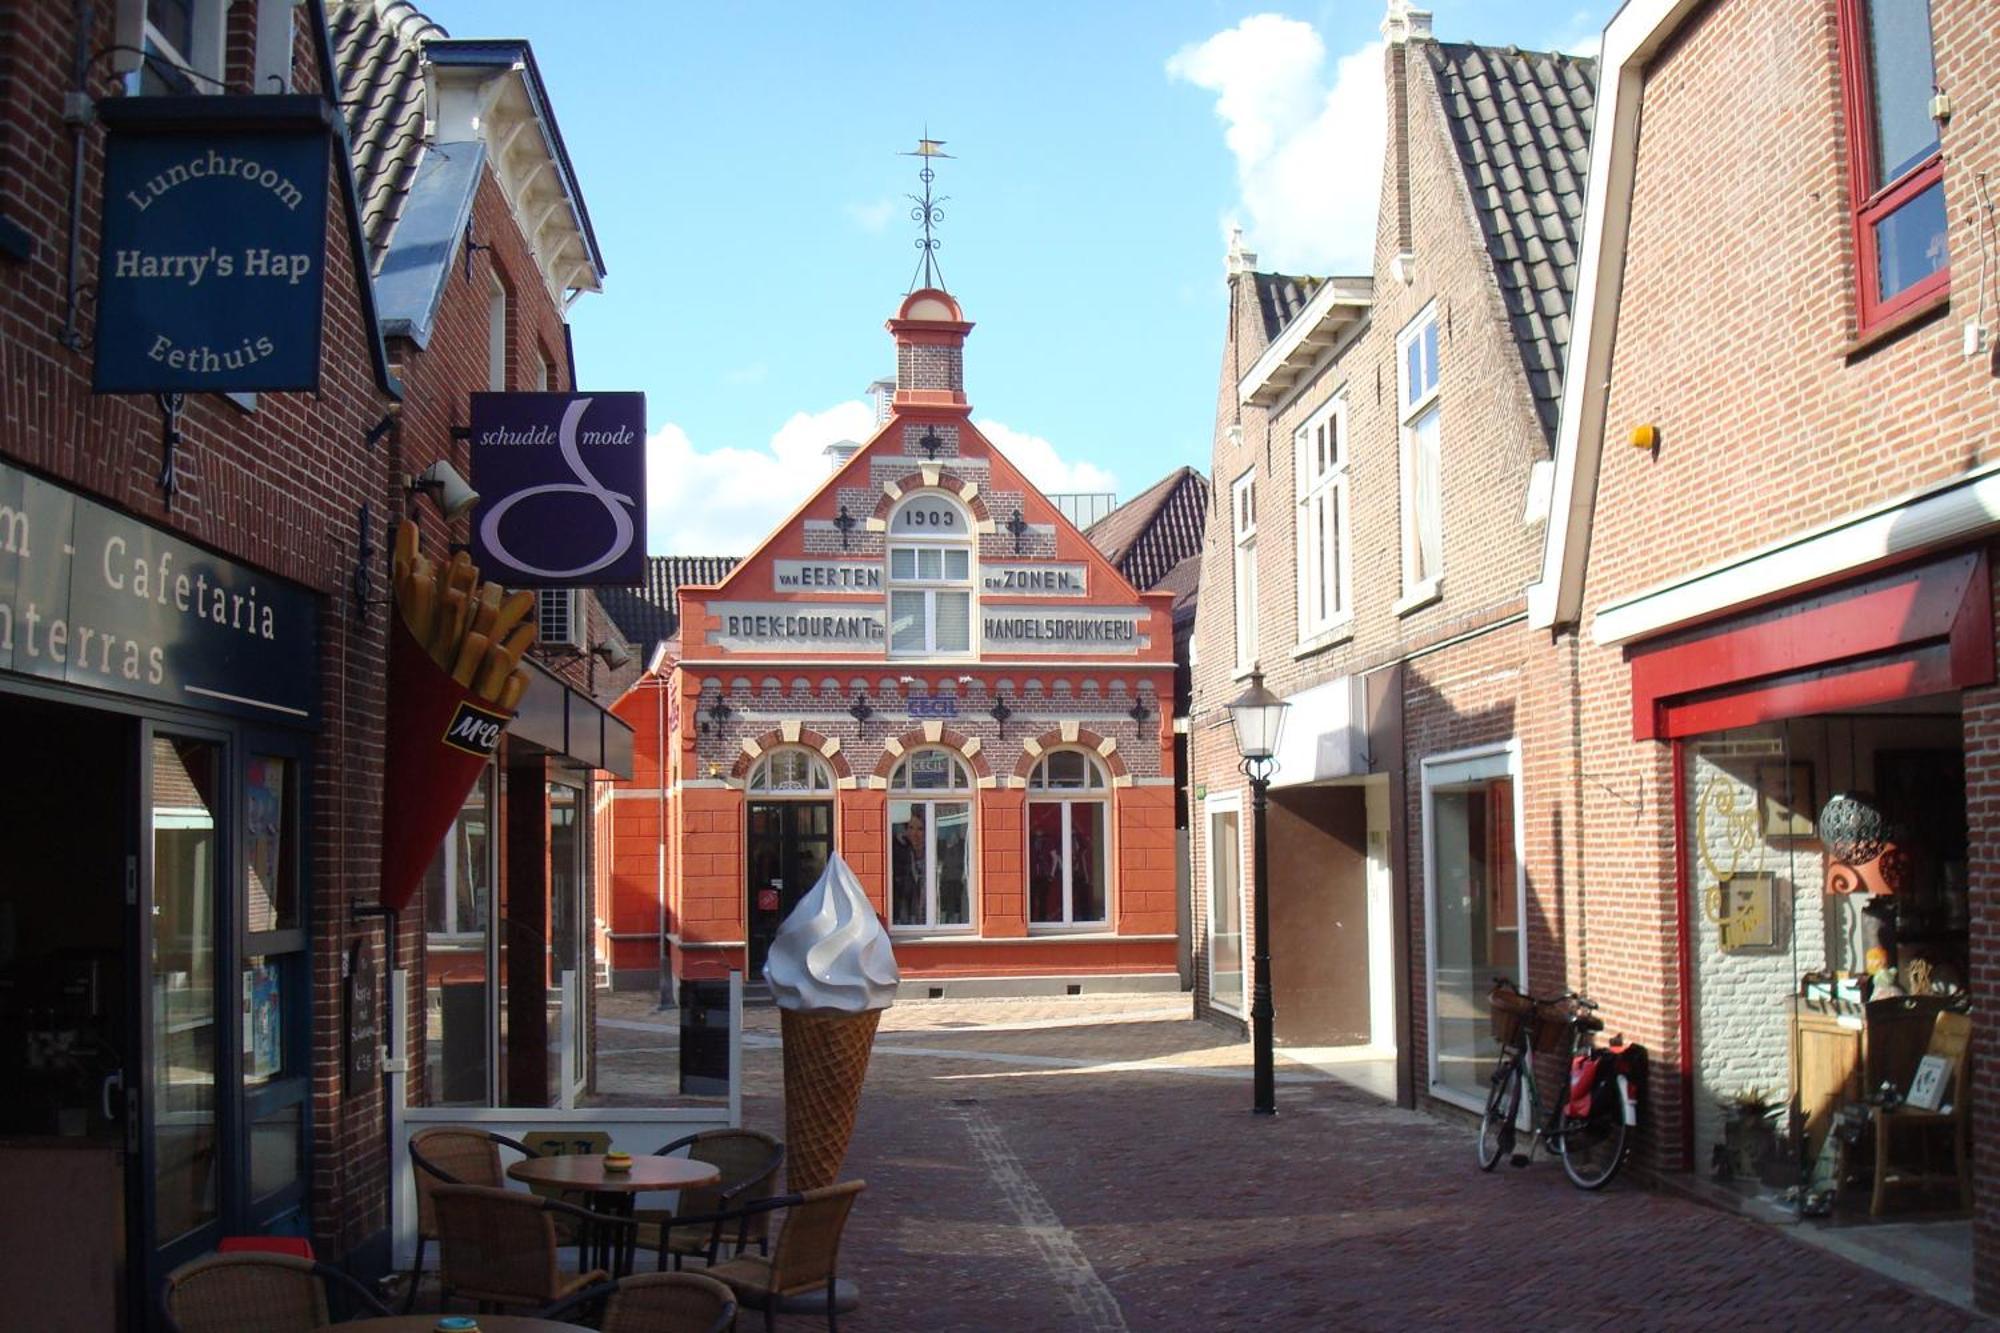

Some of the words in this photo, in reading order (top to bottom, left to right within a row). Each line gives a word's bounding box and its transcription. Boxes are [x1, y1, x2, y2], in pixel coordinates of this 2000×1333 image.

[128, 149, 303, 212] Lunchroom
[115, 247, 235, 286] Harry's
[244, 248, 311, 284] Hap
[147, 335, 274, 373] Eethuis
[480, 424, 557, 446] schudde
[582, 424, 635, 446] mode
[906, 510, 954, 526] 1903
[103, 535, 275, 640] Cafetaria
[779, 574, 799, 585] VAN
[802, 567, 879, 586] EERTEN
[984, 578, 1000, 588] EN
